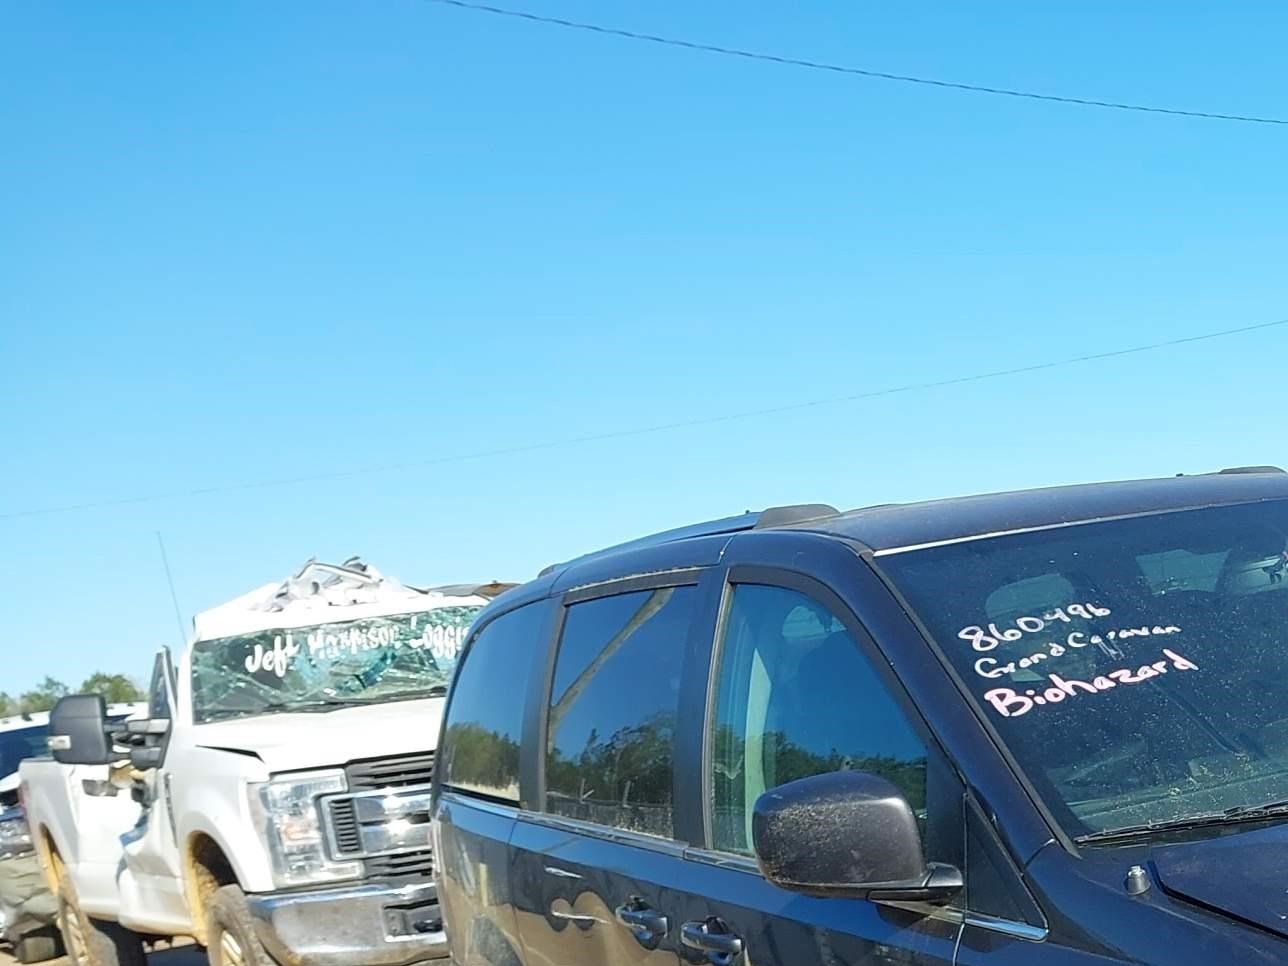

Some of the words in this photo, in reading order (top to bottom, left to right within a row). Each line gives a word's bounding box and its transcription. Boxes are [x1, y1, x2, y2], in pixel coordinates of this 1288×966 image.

[958, 603, 1111, 651] 860496
[974, 643, 1066, 678] Grand
[984, 649, 1199, 717] Biohazard
